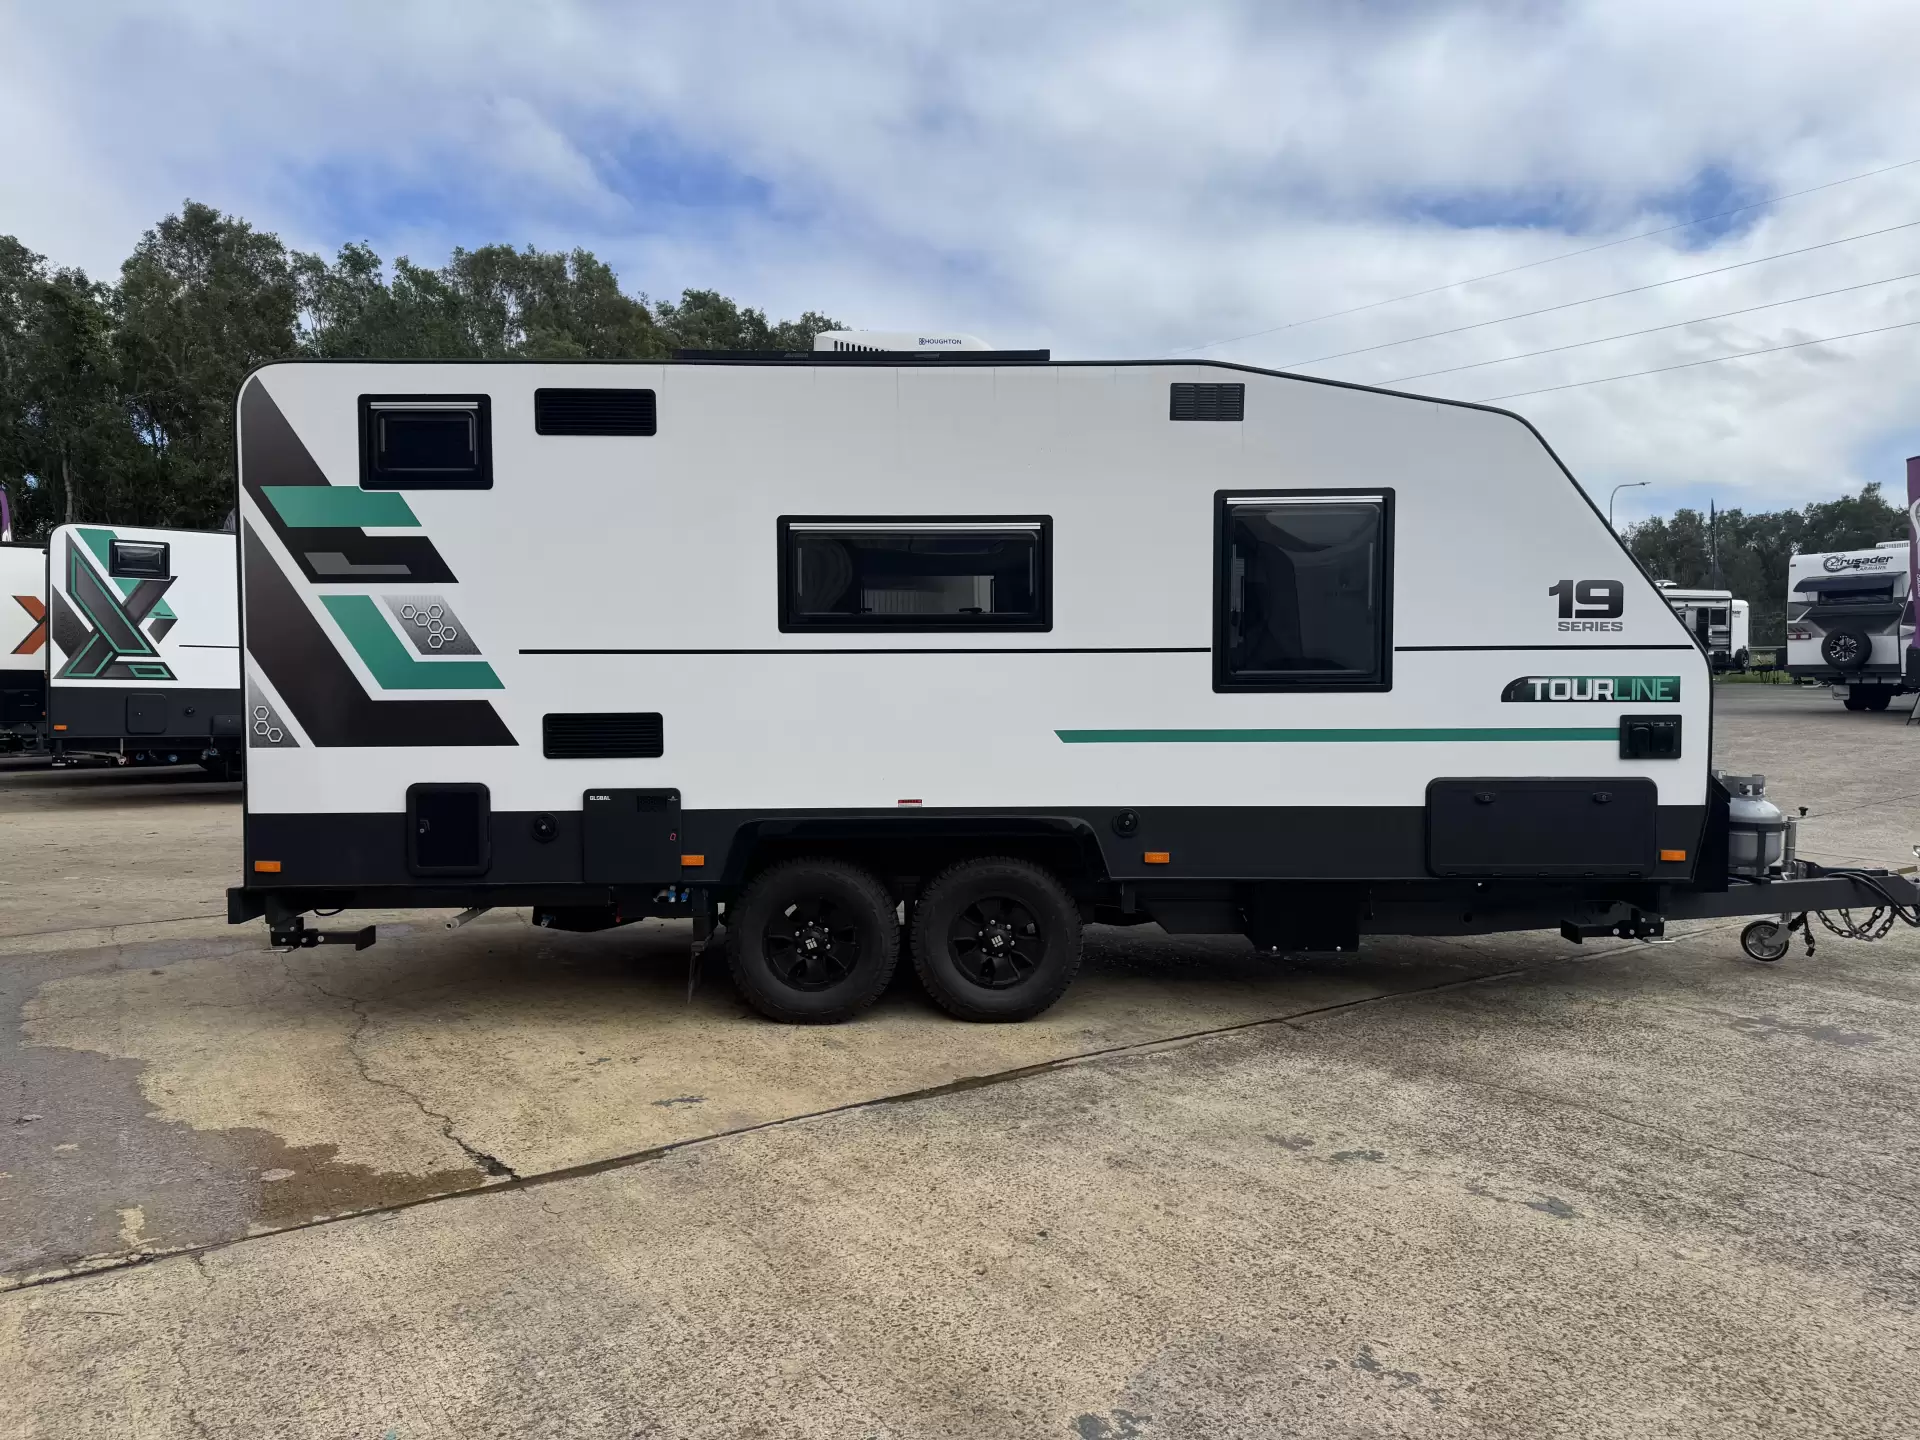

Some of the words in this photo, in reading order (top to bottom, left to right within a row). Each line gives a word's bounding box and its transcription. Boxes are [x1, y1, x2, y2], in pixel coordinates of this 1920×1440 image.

[1549, 580, 1624, 618] 19
[1557, 621, 1624, 632] SERIES
[1528, 678, 1674, 701] TOURLINE
